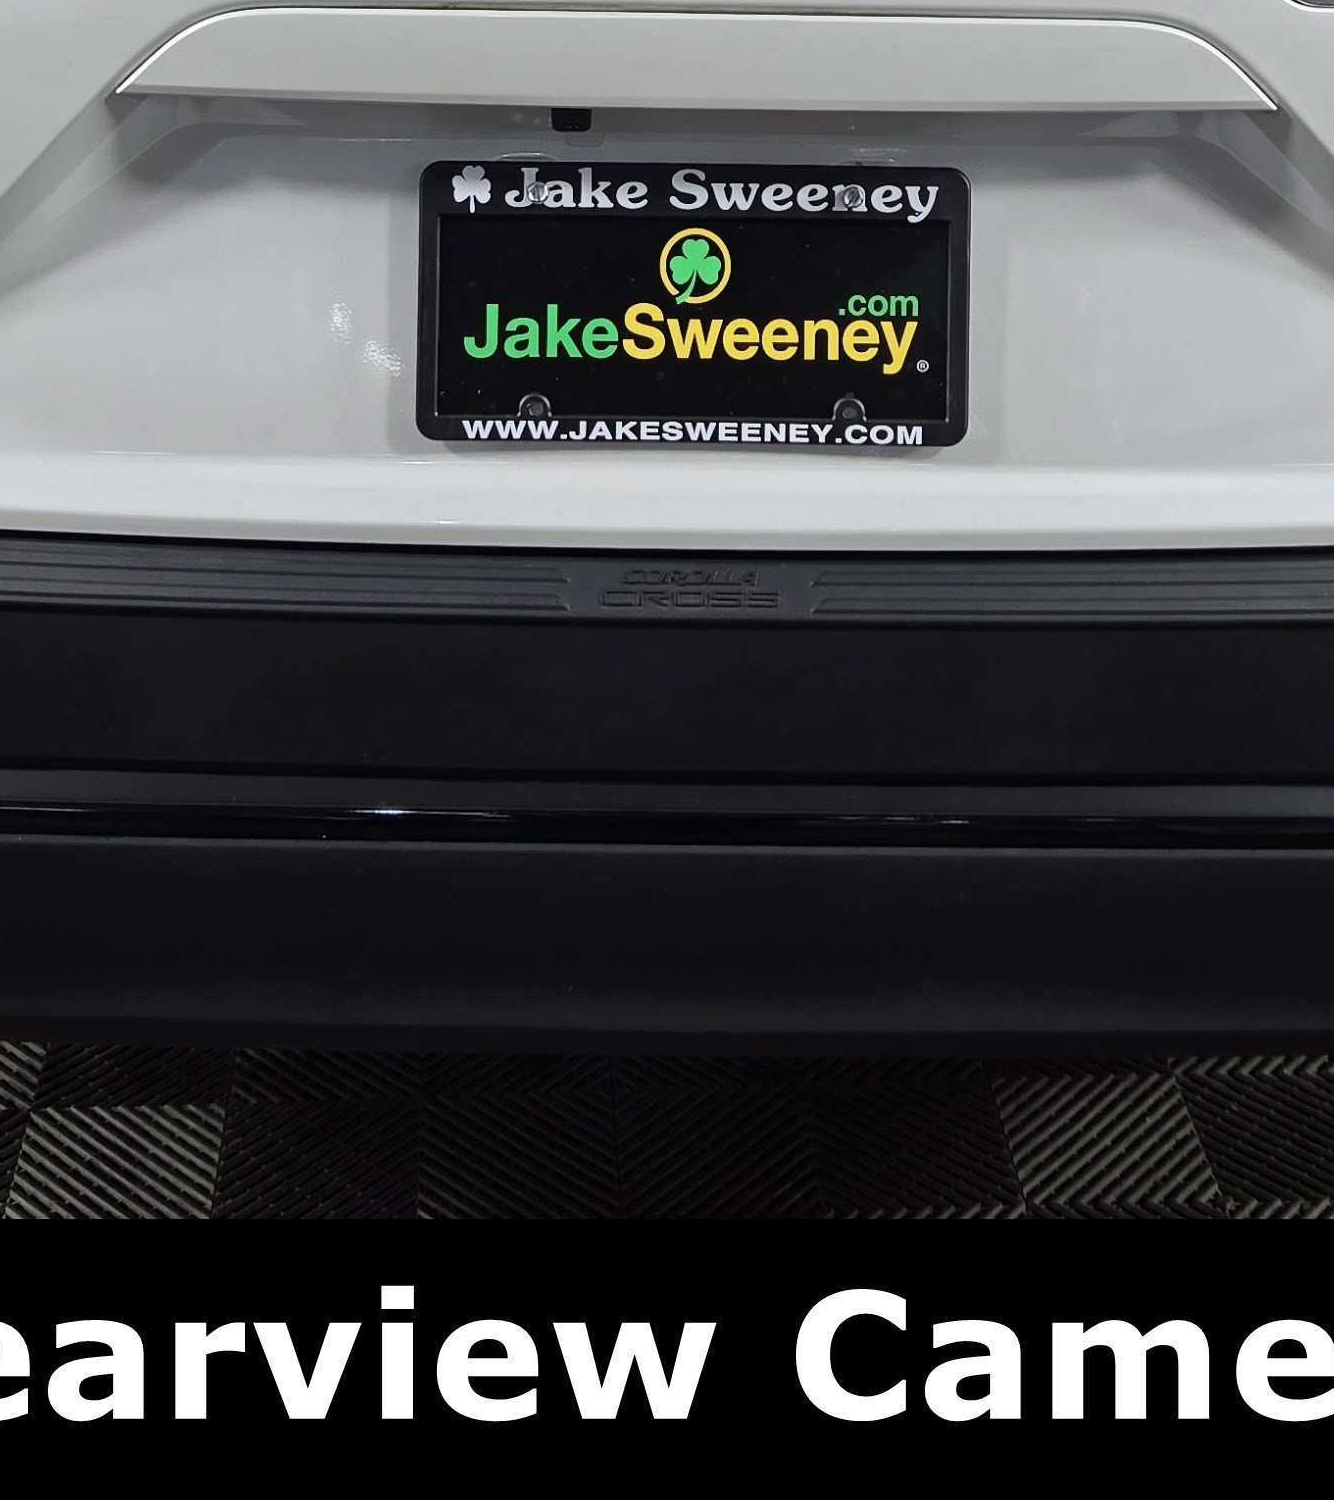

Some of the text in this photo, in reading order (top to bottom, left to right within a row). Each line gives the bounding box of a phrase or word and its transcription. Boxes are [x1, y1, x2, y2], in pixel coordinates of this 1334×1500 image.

[505, 167, 940, 224] Jake Sweeney
[462, 420, 924, 445] WWW.JAKESWEENEY.COM
[622, 569, 759, 586] COROLLA
[599, 590, 780, 608] CROSS
